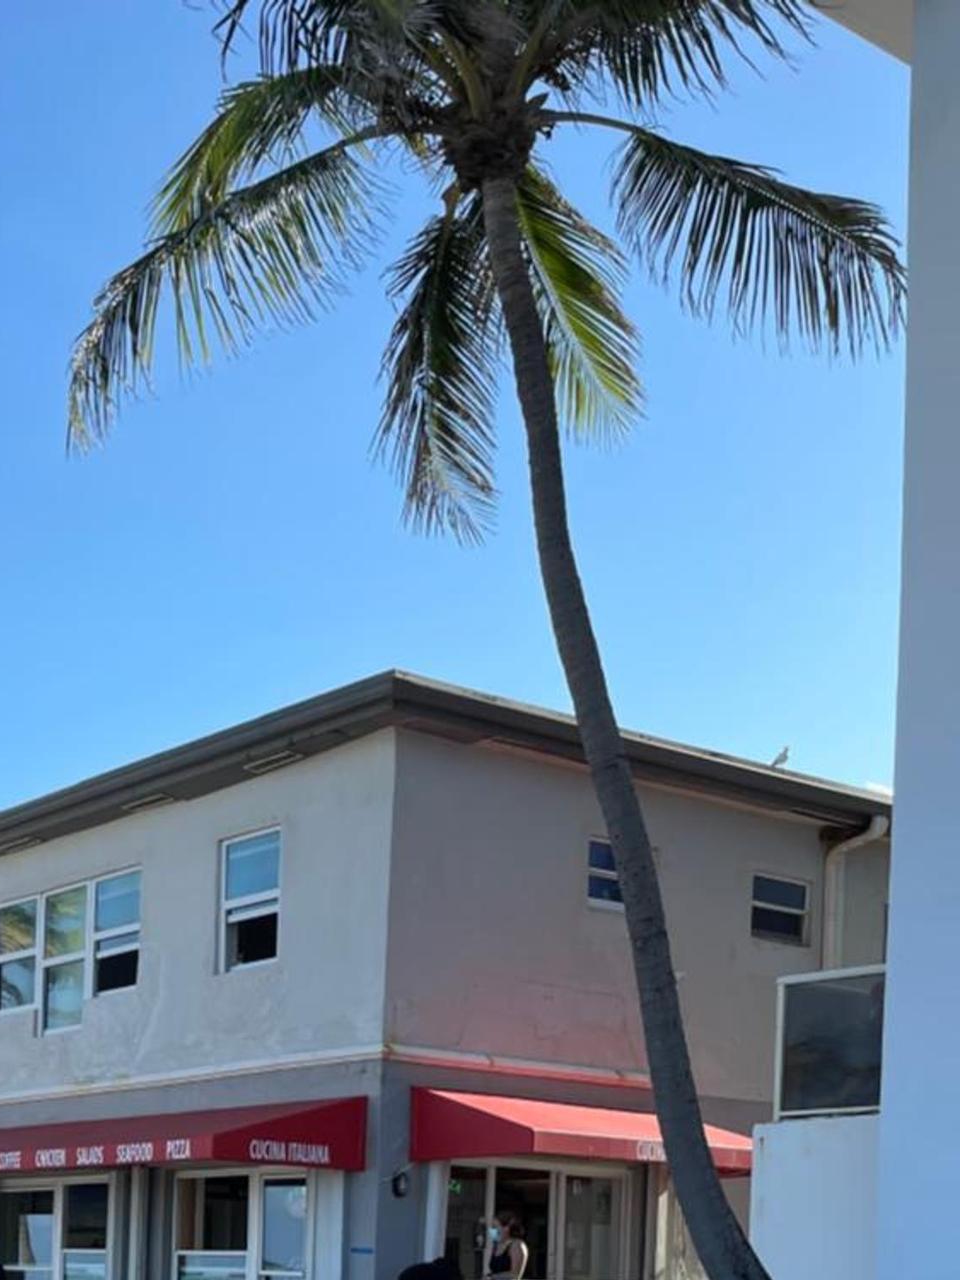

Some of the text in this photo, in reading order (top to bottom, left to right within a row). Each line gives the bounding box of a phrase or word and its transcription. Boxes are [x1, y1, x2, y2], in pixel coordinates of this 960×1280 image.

[35, 1148, 66, 1168] CHICKEN
[76, 1146, 104, 1166] SALADS
[116, 1142, 153, 1164] SEAFOOD
[166, 1139, 190, 1160] PIZZA
[249, 1138, 330, 1164] CUCINA ITALIANA
